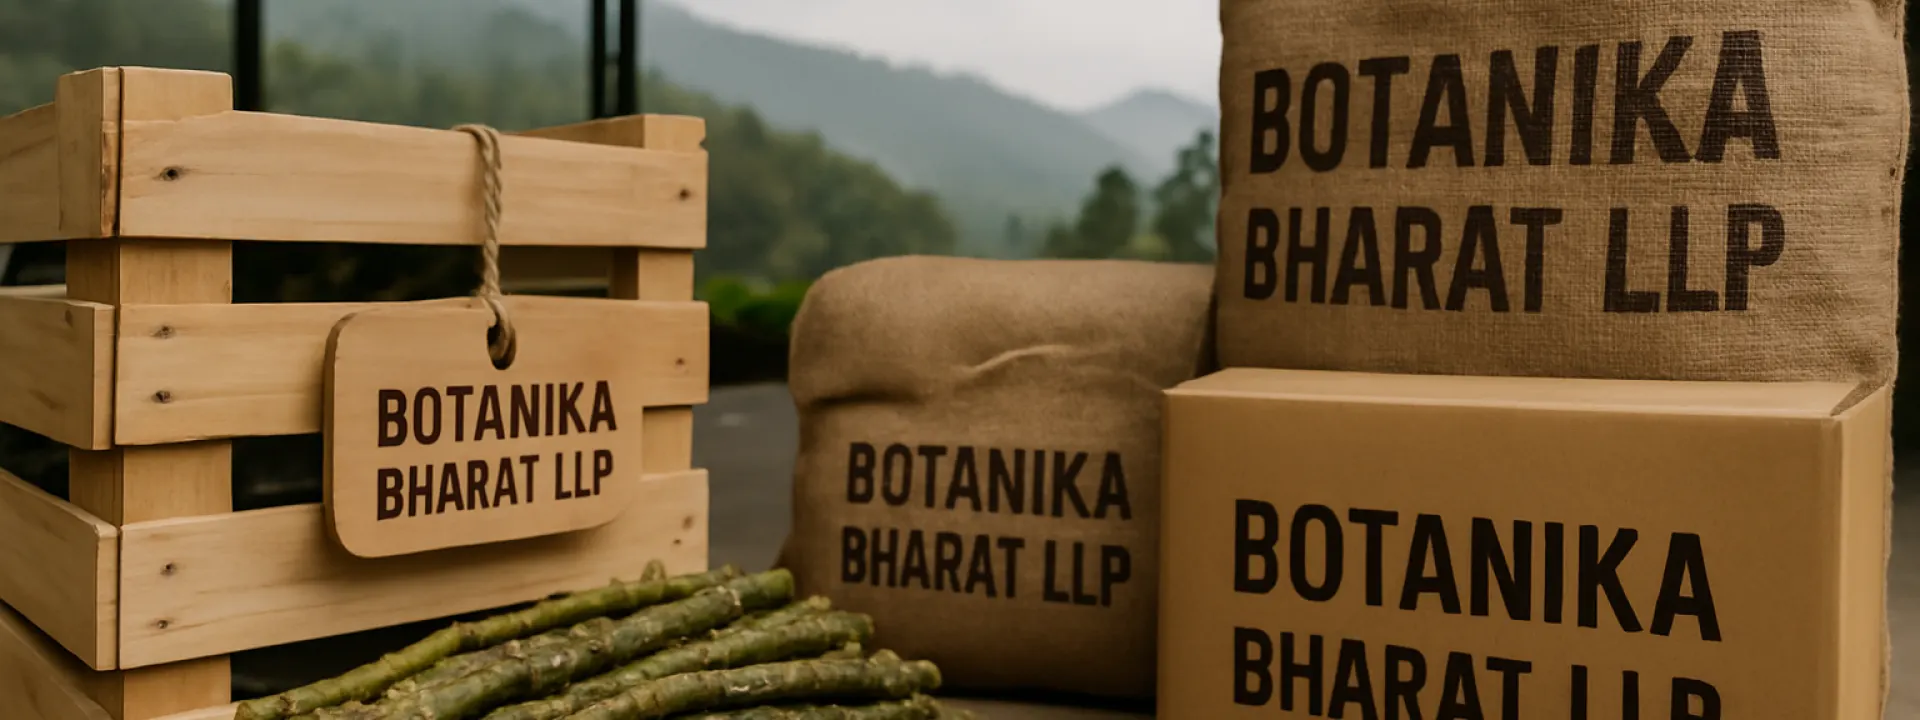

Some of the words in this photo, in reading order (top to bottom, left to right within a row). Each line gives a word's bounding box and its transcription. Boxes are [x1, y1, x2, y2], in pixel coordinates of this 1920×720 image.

[1249, 29, 1780, 175] BOTANIKA
[1243, 204, 1563, 314] BHARAT
[1602, 203, 1785, 315] LLP
[377, 380, 618, 448] BOTANIKA
[376, 454, 540, 522] BHARAT
[554, 449, 614, 501] LLP
[846, 442, 1132, 521] BOTANIKA
[840, 525, 1026, 599] BHARAT
[1042, 538, 1132, 608] LLP
[1234, 499, 1723, 643] BOTANIKA
[1233, 626, 1533, 720] BHARAT
